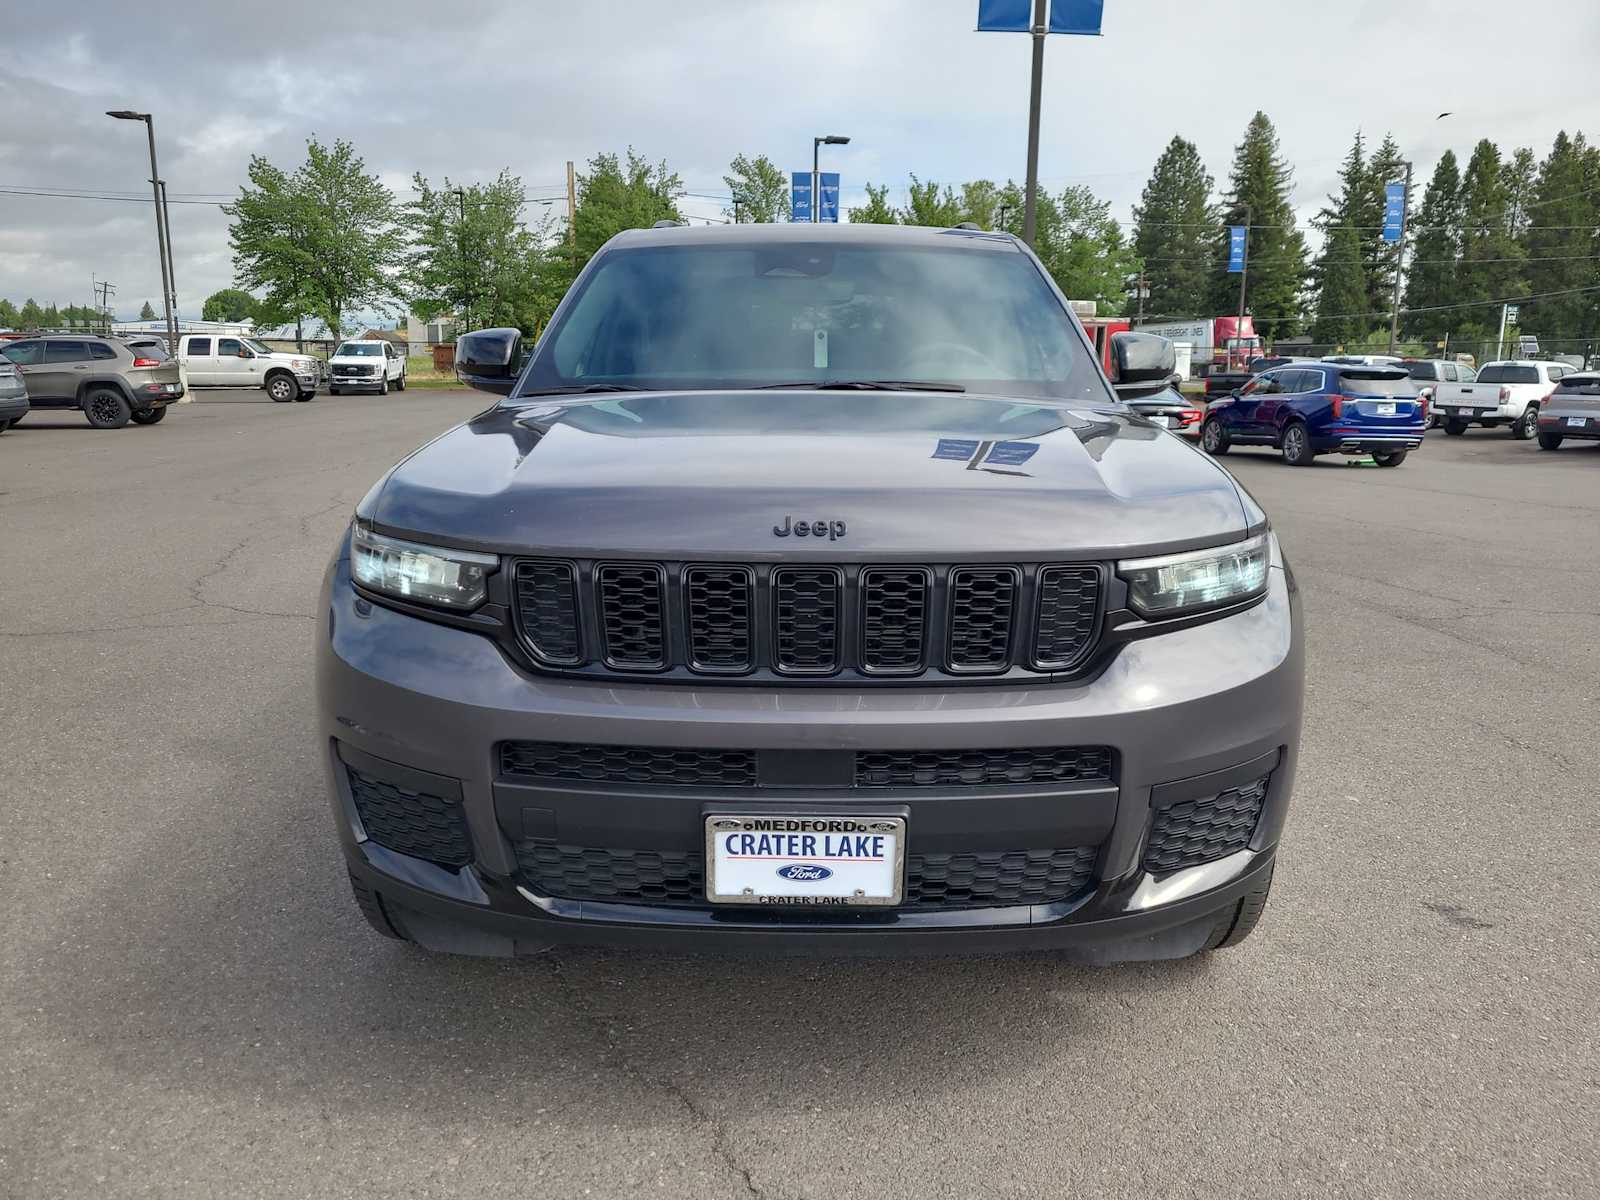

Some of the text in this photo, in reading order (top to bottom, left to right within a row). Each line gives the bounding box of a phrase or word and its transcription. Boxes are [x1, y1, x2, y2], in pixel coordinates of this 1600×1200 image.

[773, 516, 847, 541] Jeep
[755, 820, 857, 833] MEDFORD
[725, 834, 884, 858] CRATER LAKE
[787, 866, 822, 881] Ford
[759, 896, 849, 905] CRATER LAKE
